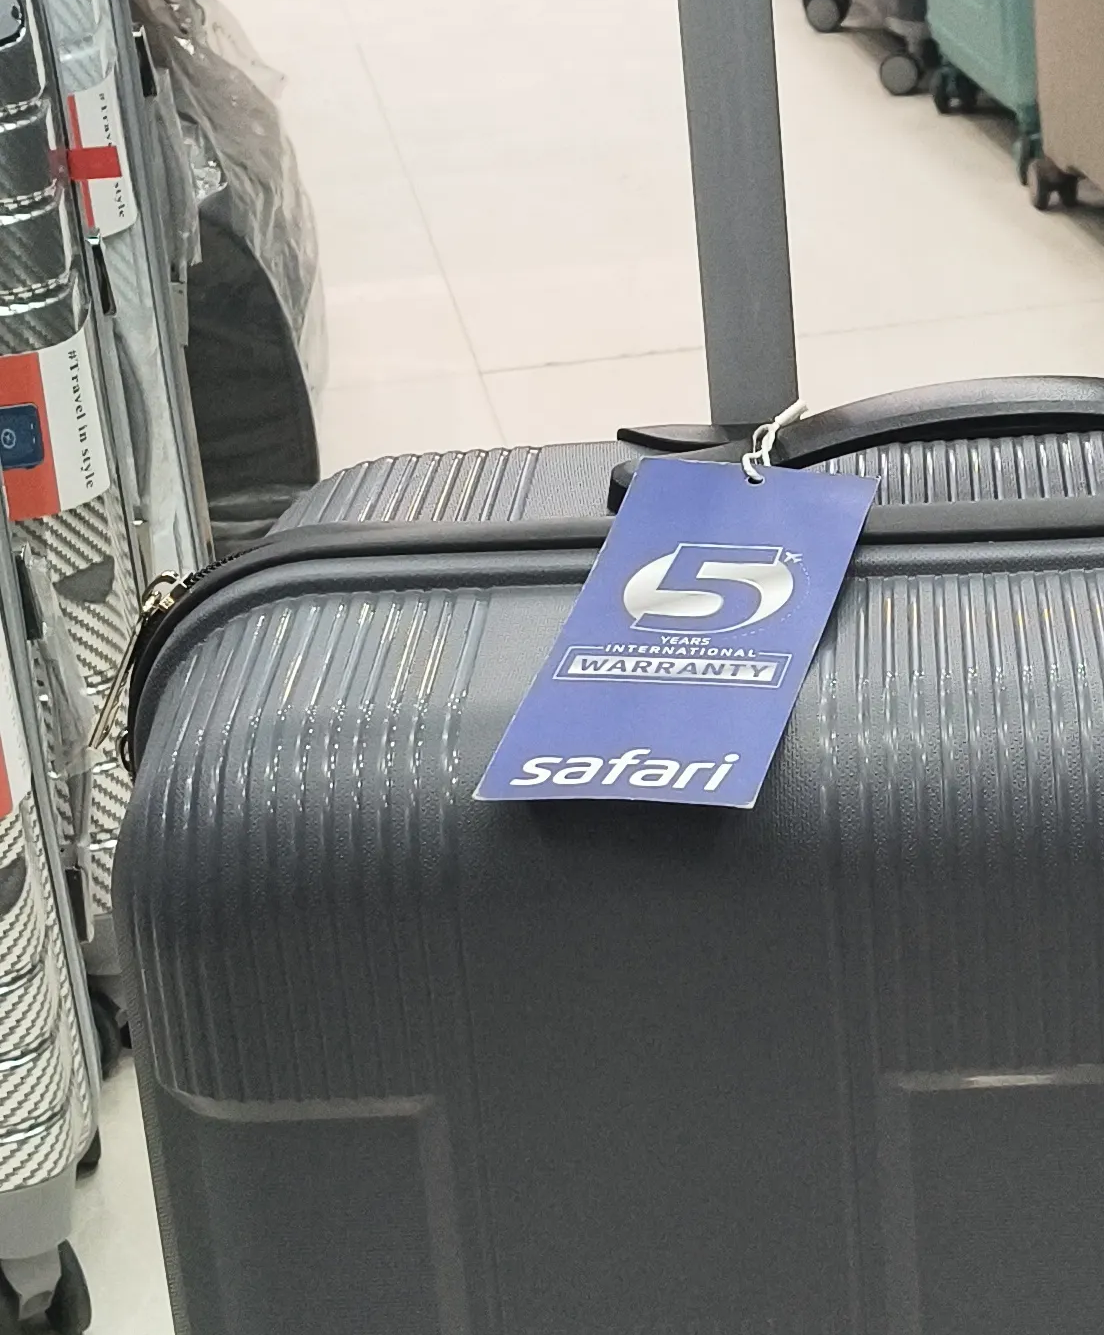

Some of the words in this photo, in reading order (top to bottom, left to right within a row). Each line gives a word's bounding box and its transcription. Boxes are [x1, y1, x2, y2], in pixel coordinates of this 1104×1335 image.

[77, 423, 90, 444] in
[80, 447, 96, 489] style
[629, 542, 784, 635] 5
[604, 643, 757, 658] INTERNATIONAL
[660, 635, 712, 646] YEARS
[579, 657, 769, 678] WARRANTY
[509, 748, 740, 792] safari
